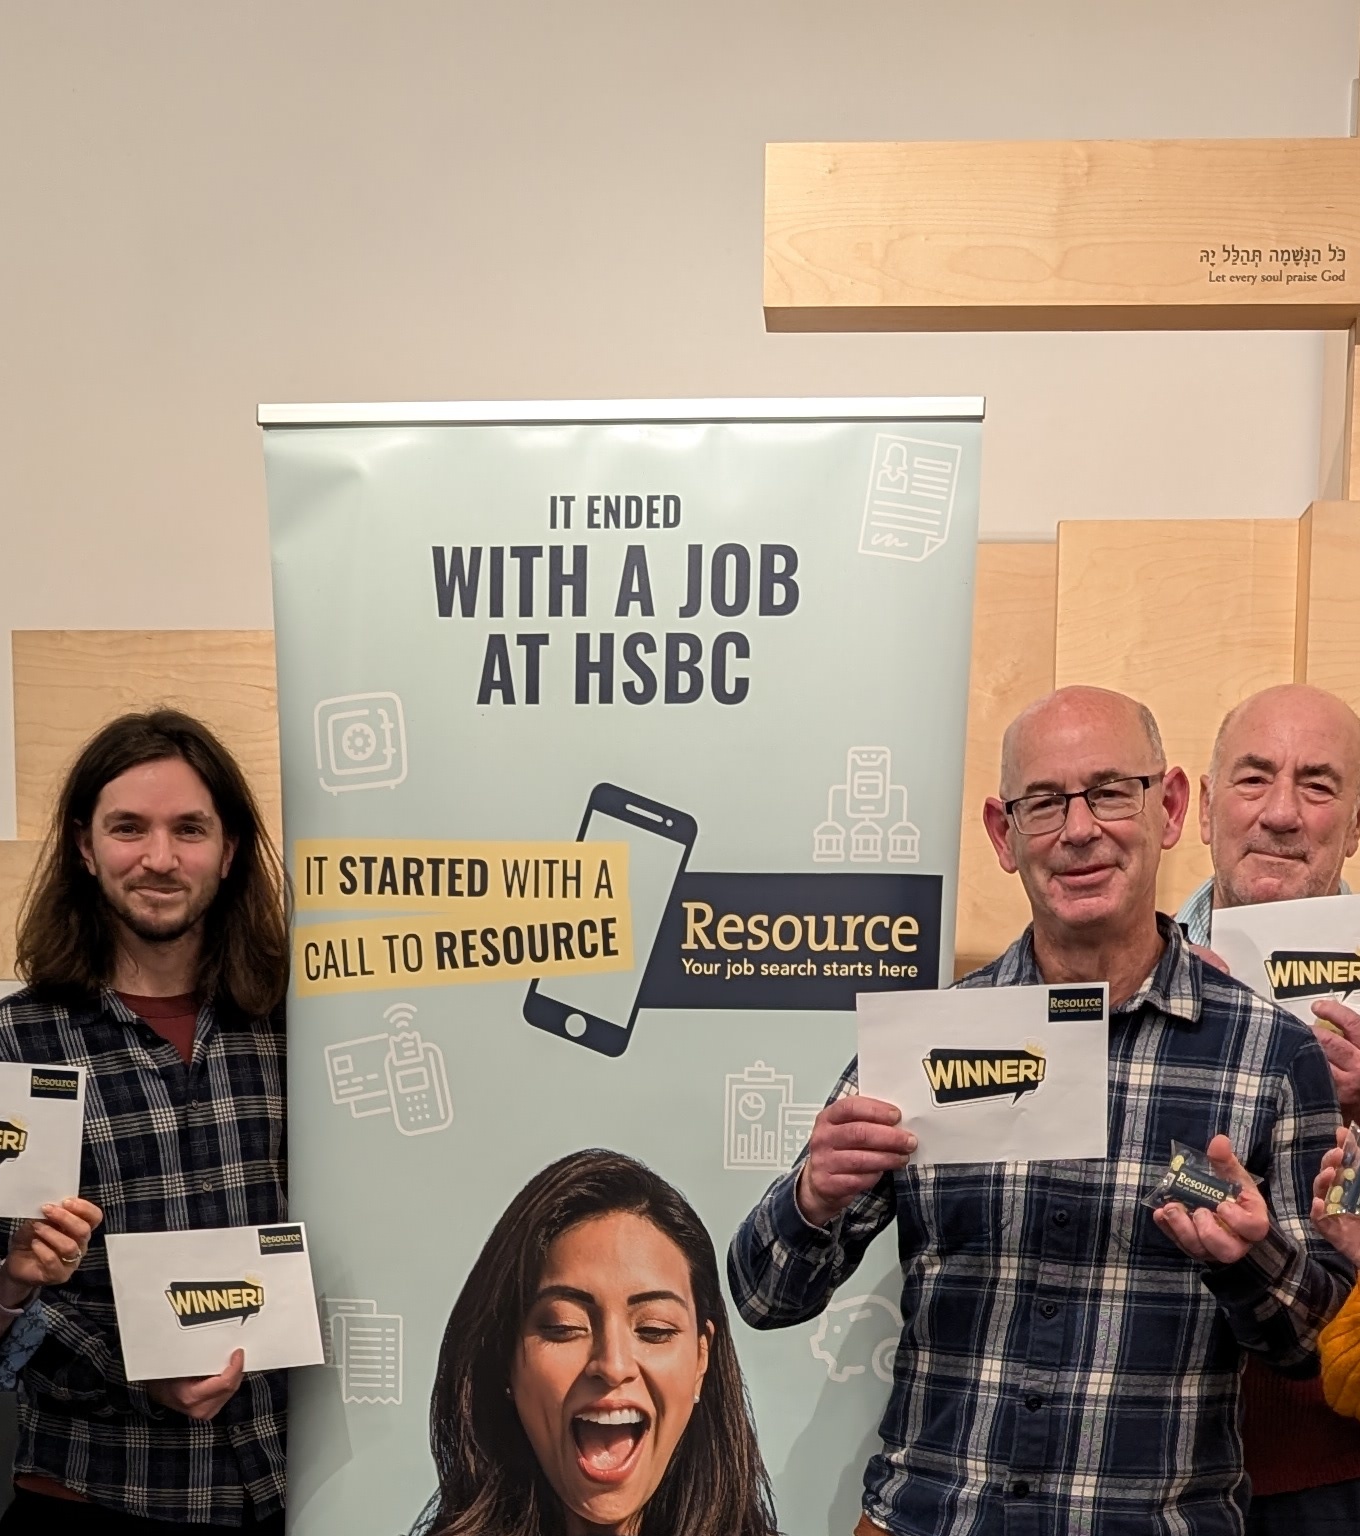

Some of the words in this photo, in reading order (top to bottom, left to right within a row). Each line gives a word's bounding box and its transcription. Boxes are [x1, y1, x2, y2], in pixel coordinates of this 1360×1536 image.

[1209, 270, 1226, 282] Let
[1229, 274, 1258, 286] every
[1261, 270, 1283, 282] soul
[1286, 271, 1318, 286] praise
[1321, 269, 1346, 282] God
[549, 495, 576, 530] IT
[586, 494, 682, 530] ENDED
[431, 545, 588, 618] WITH
[614, 544, 656, 618] A
[678, 542, 800, 619] JOB
[476, 632, 550, 706] AT
[574, 631, 751, 706] HSBC
[305, 856, 328, 896] IT
[339, 855, 489, 897] STARTED
[502, 859, 582, 899] WITH
[594, 859, 614, 899] A
[681, 901, 920, 953] Resource
[304, 937, 375, 982] CALL
[382, 933, 424, 974] TO
[434, 917, 619, 971] RESOURCE
[681, 958, 722, 976] Your
[725, 958, 755, 980] job
[760, 959, 817, 976] search
[823, 960, 873, 977] starts
[879, 959, 919, 978] here
[1050, 997, 1102, 1009] Resource
[32, 1075, 78, 1088] Resource
[923, 1059, 1045, 1091] WINNER!
[1176, 1171, 1225, 1200] Resource
[167, 1287, 264, 1316] WINNER!
